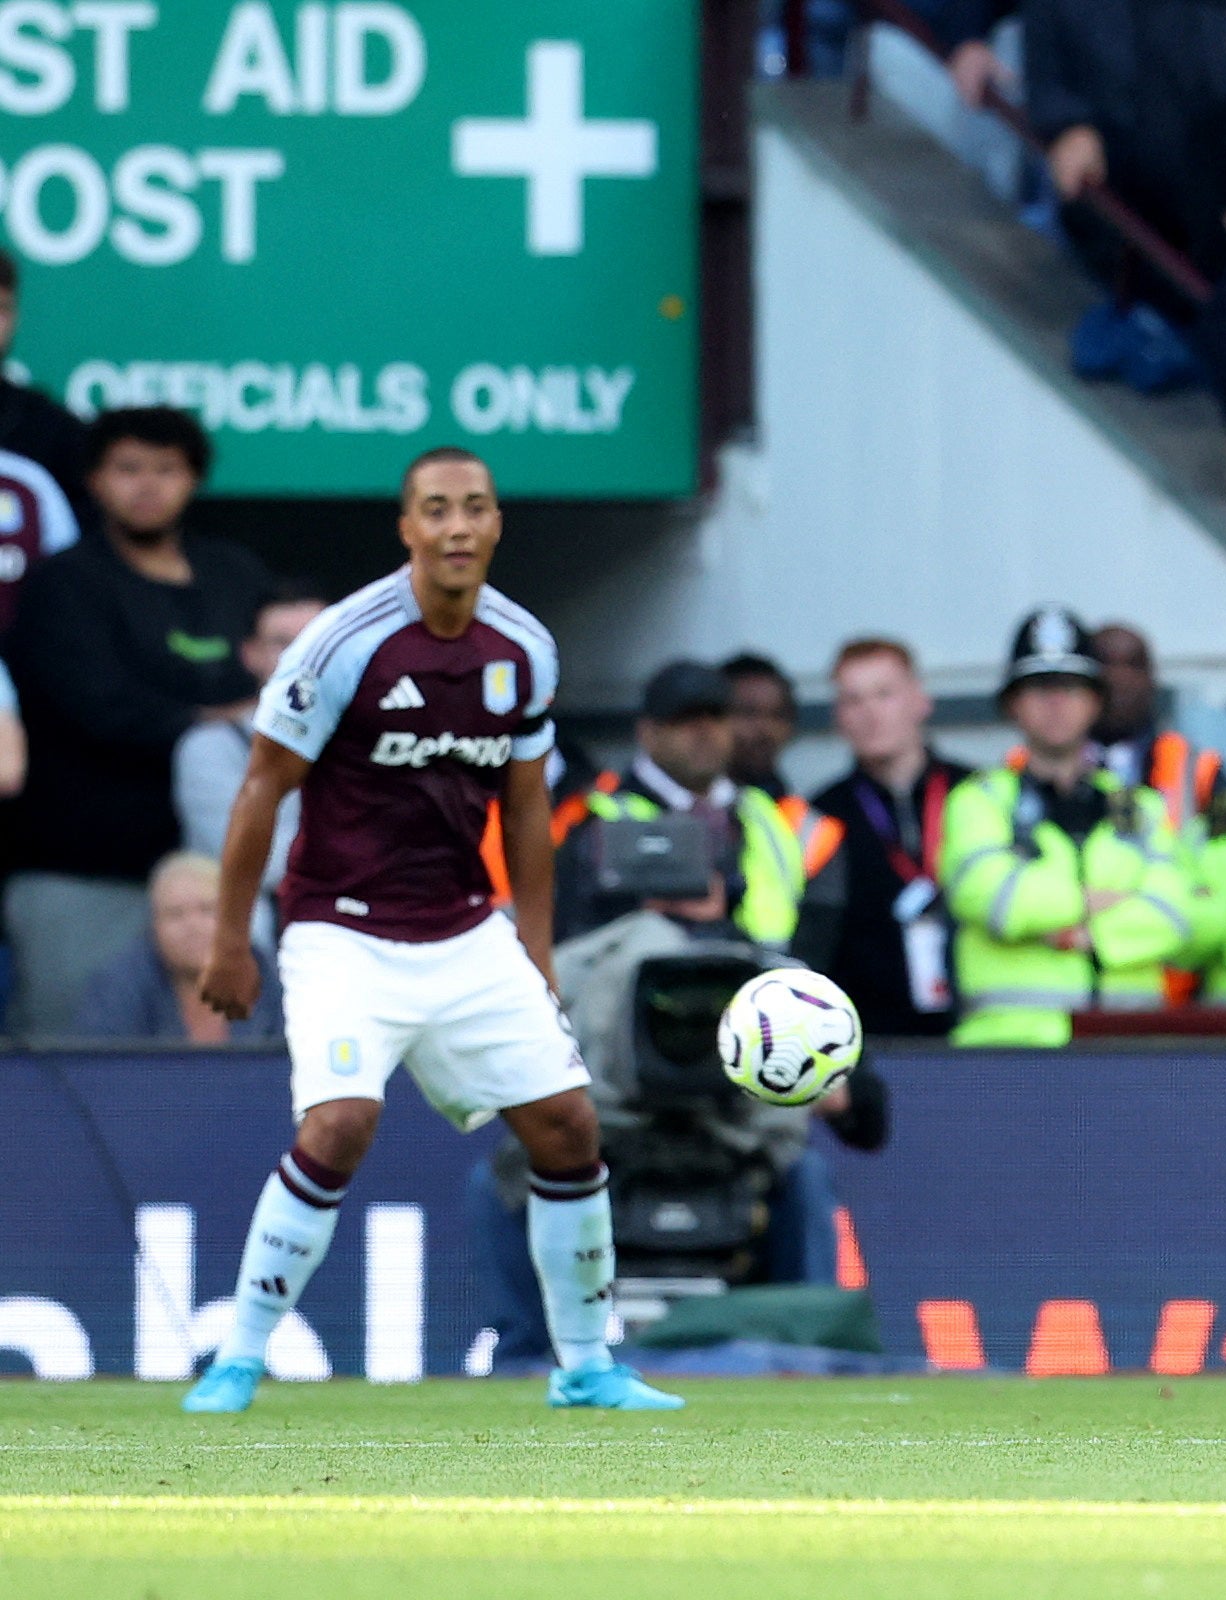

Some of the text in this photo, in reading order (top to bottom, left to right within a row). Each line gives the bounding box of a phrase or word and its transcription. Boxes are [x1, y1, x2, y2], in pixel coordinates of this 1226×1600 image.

[204, 2, 427, 116] AID
[0, 144, 285, 266] OST
[450, 362, 635, 434] ONLY
